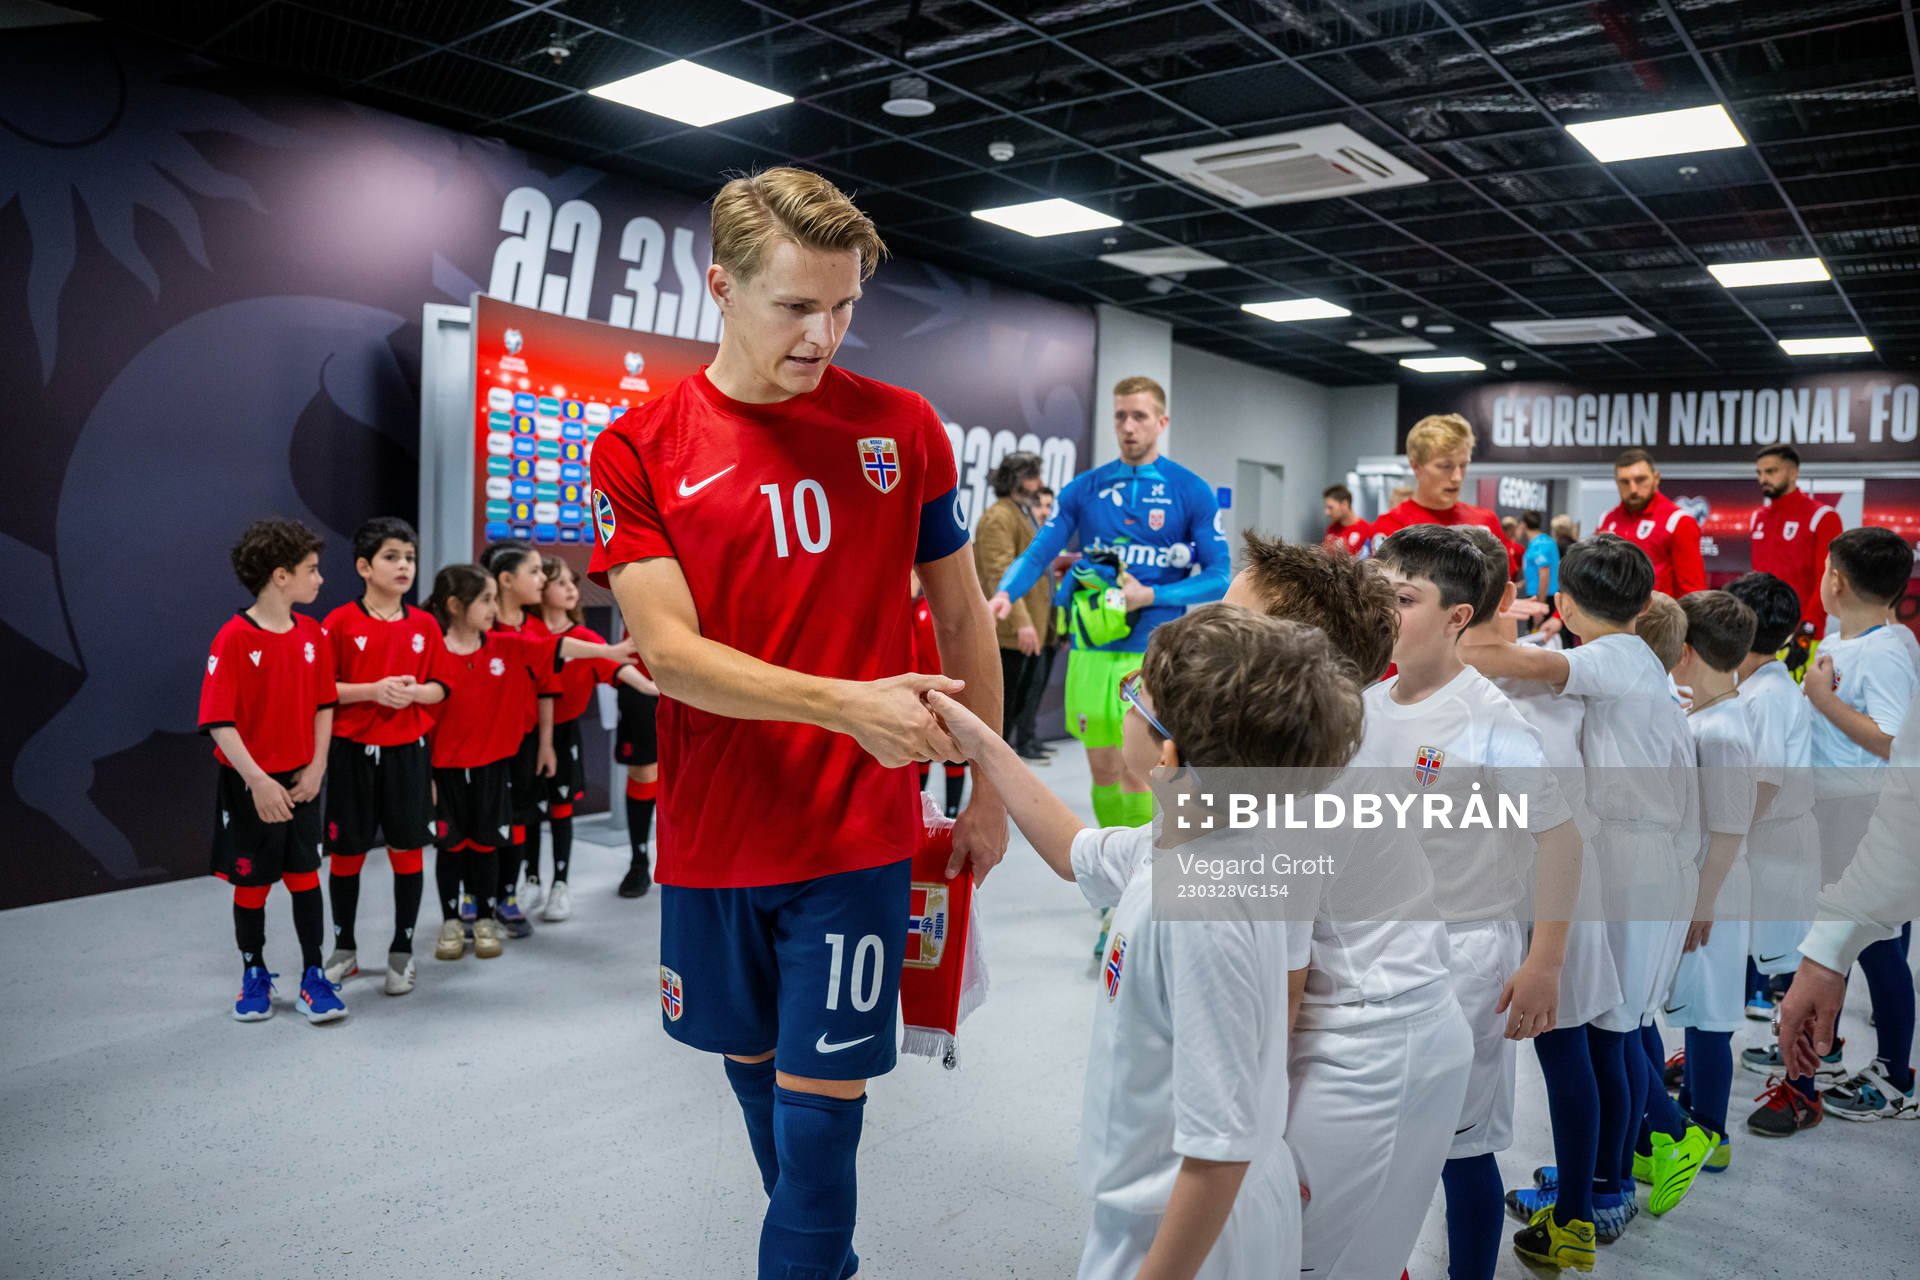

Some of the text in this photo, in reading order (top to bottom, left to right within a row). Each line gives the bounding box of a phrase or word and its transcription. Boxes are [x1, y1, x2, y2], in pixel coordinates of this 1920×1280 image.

[1492, 383, 1919, 447] GEORGIAN NATIONAL FO
[760, 478, 832, 558] 10
[935, 912, 944, 940] NORGE
[825, 933, 884, 1013] 10
